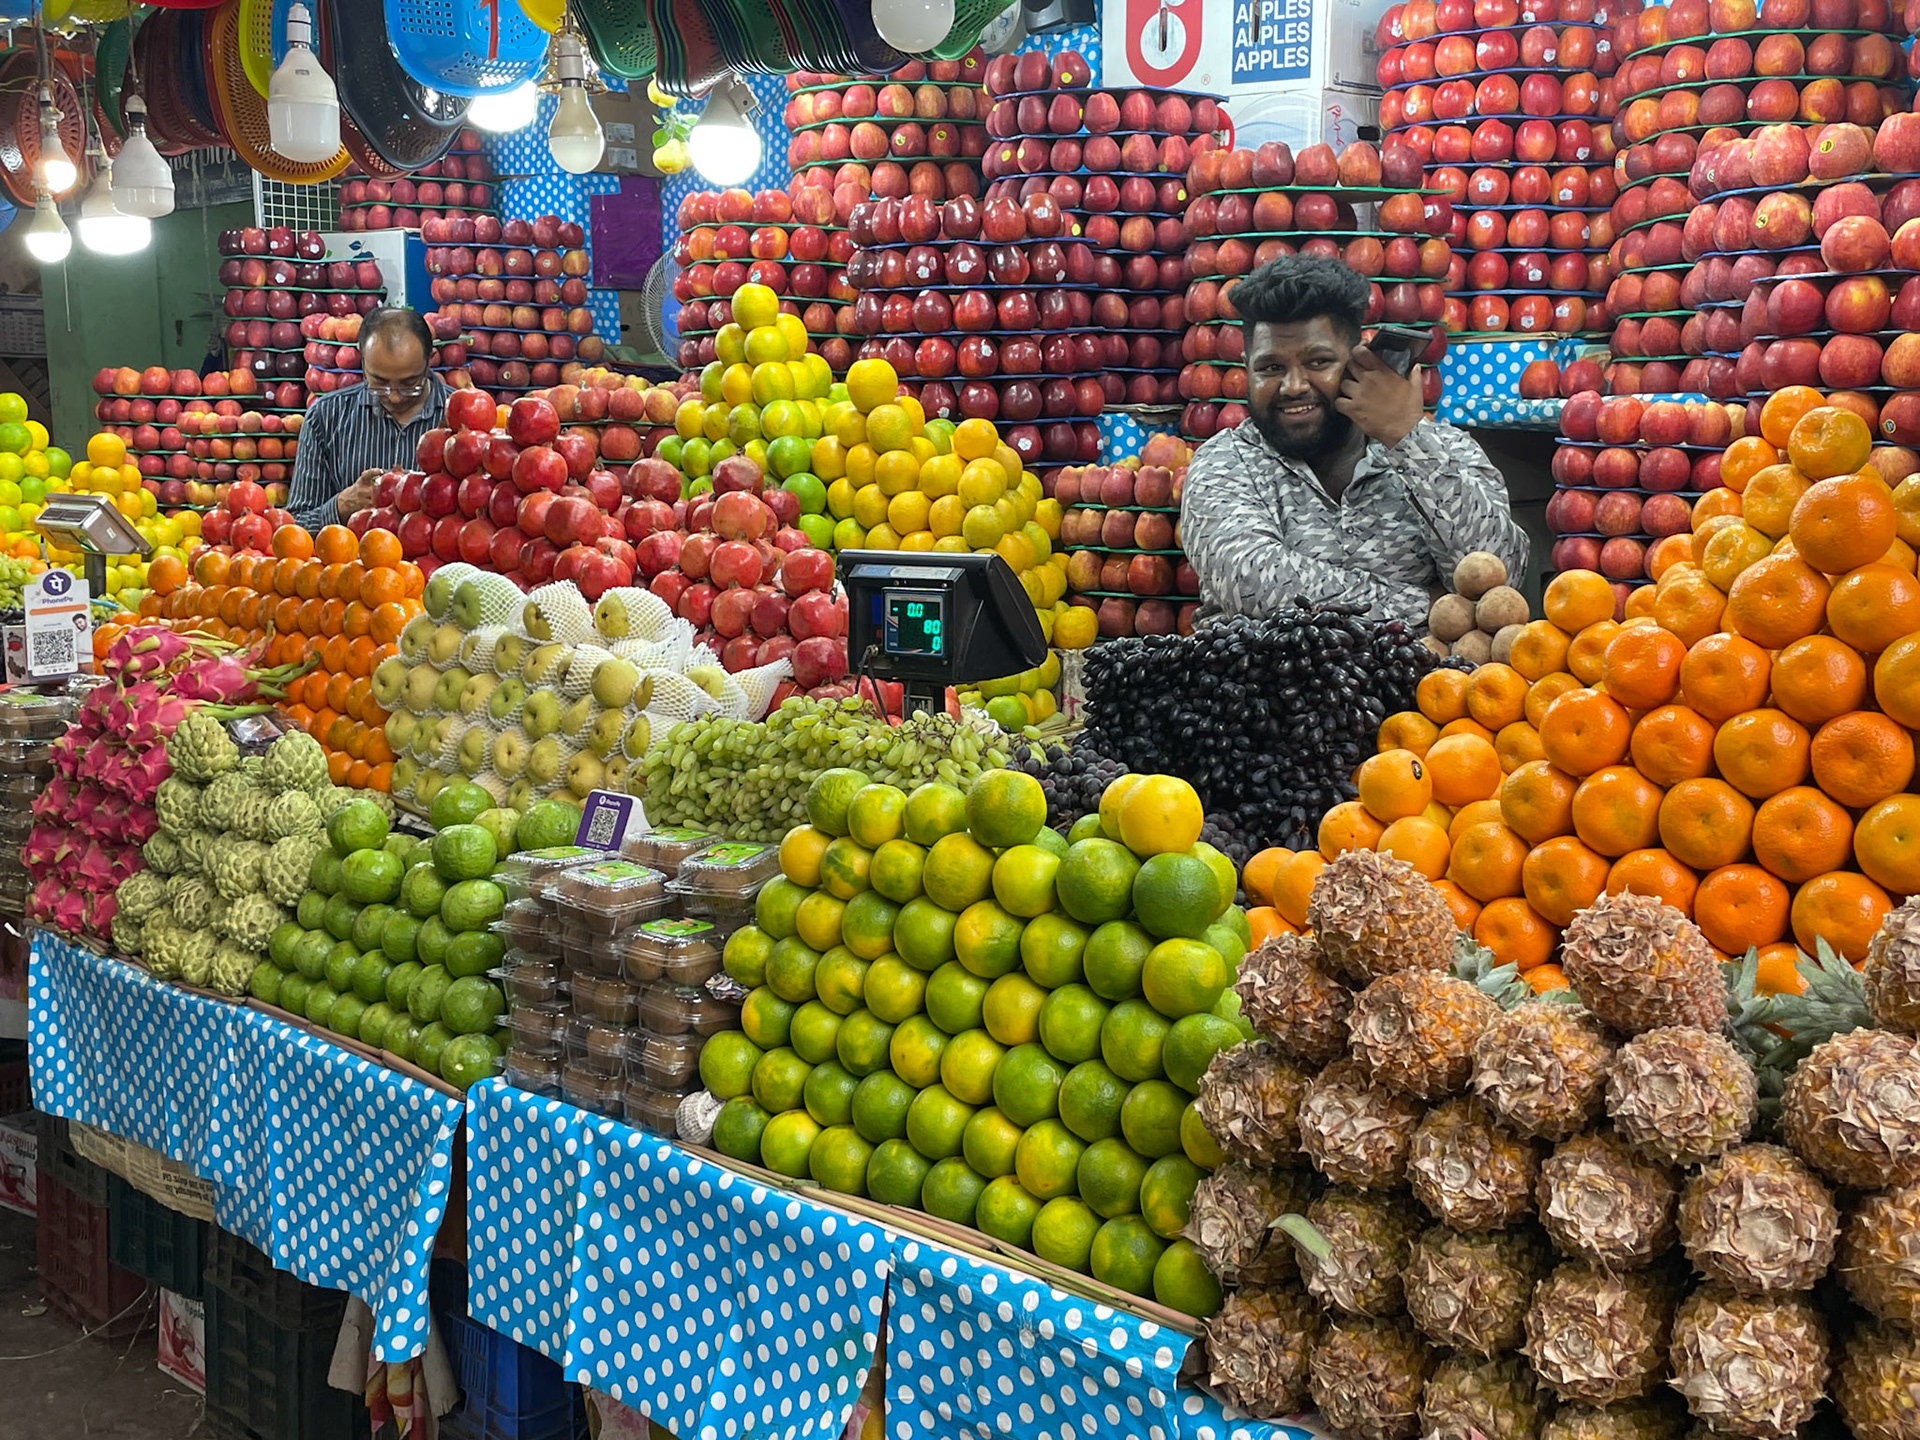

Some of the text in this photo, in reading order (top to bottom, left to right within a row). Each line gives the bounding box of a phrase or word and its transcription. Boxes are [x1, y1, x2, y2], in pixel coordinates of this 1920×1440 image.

[1234, 45, 1309, 72] APPLES
[41, 596, 73, 605] PhonePe
[923, 619, 942, 634] 80
[932, 636, 941, 650] 0
